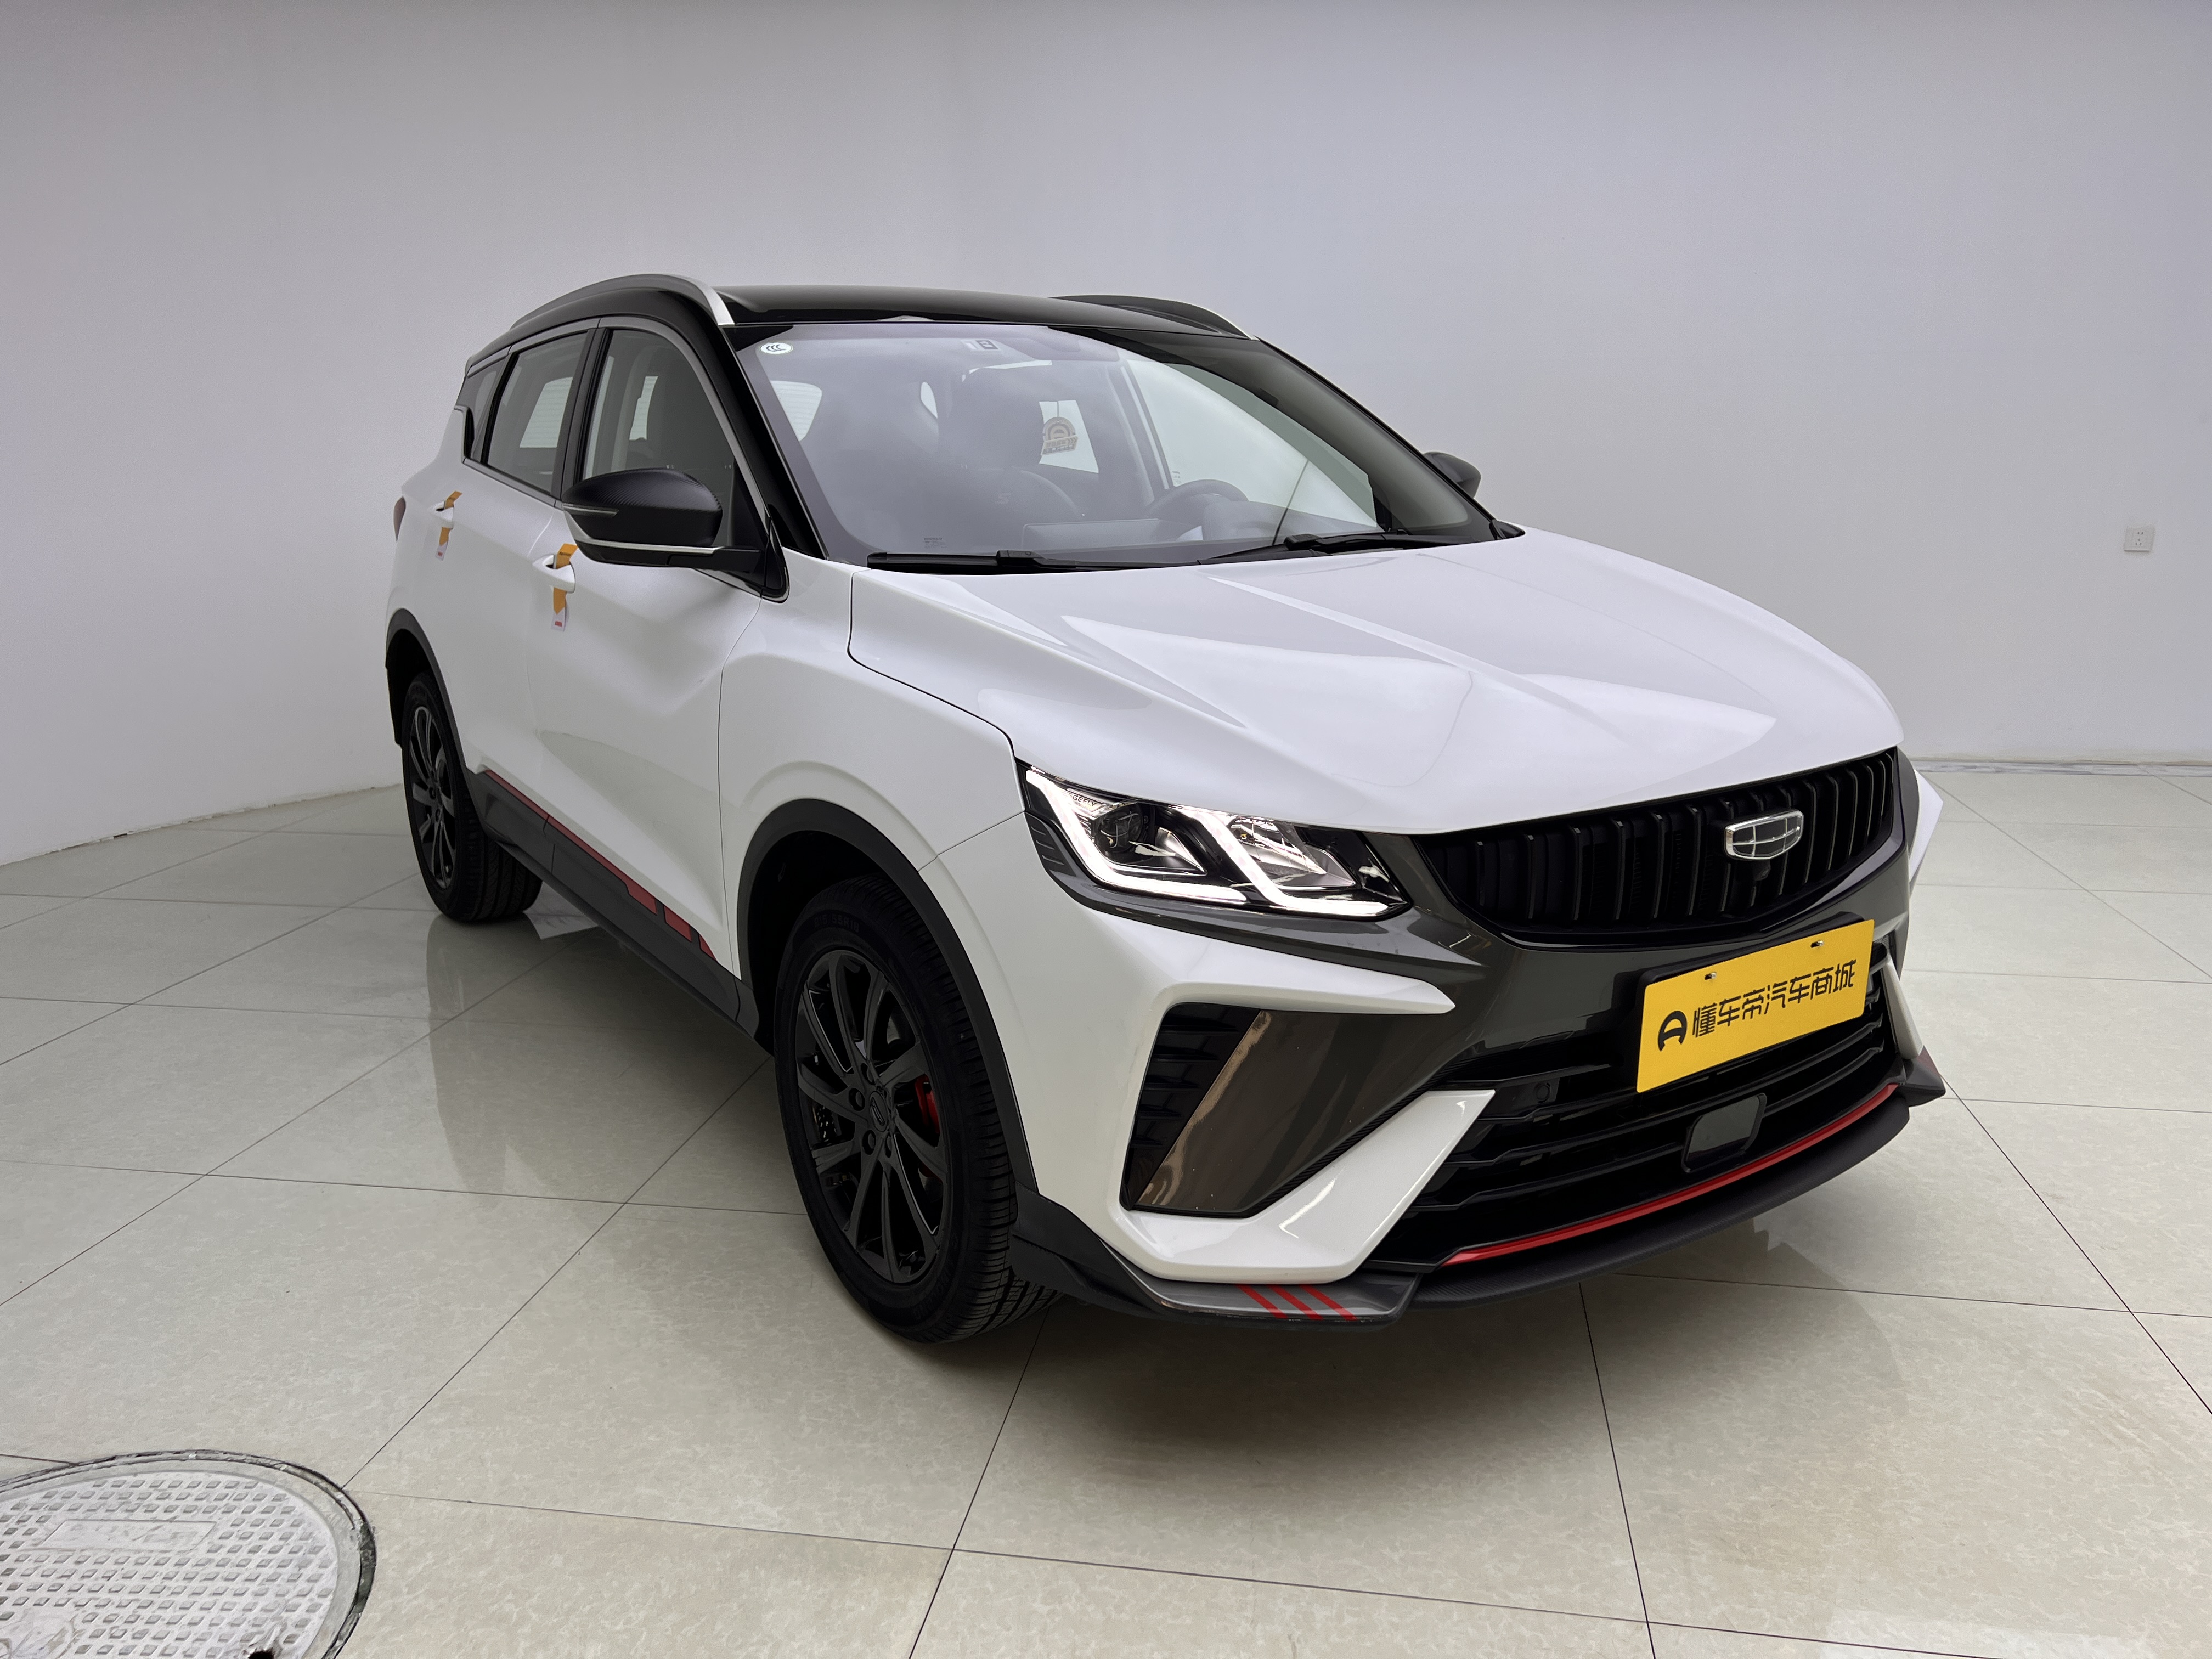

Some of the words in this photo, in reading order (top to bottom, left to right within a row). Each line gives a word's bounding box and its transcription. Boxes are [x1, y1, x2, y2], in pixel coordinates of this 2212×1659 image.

[1073, 794, 1097, 806] GEELY
[1692, 959, 1857, 1038] 懂车帝汽车商城
